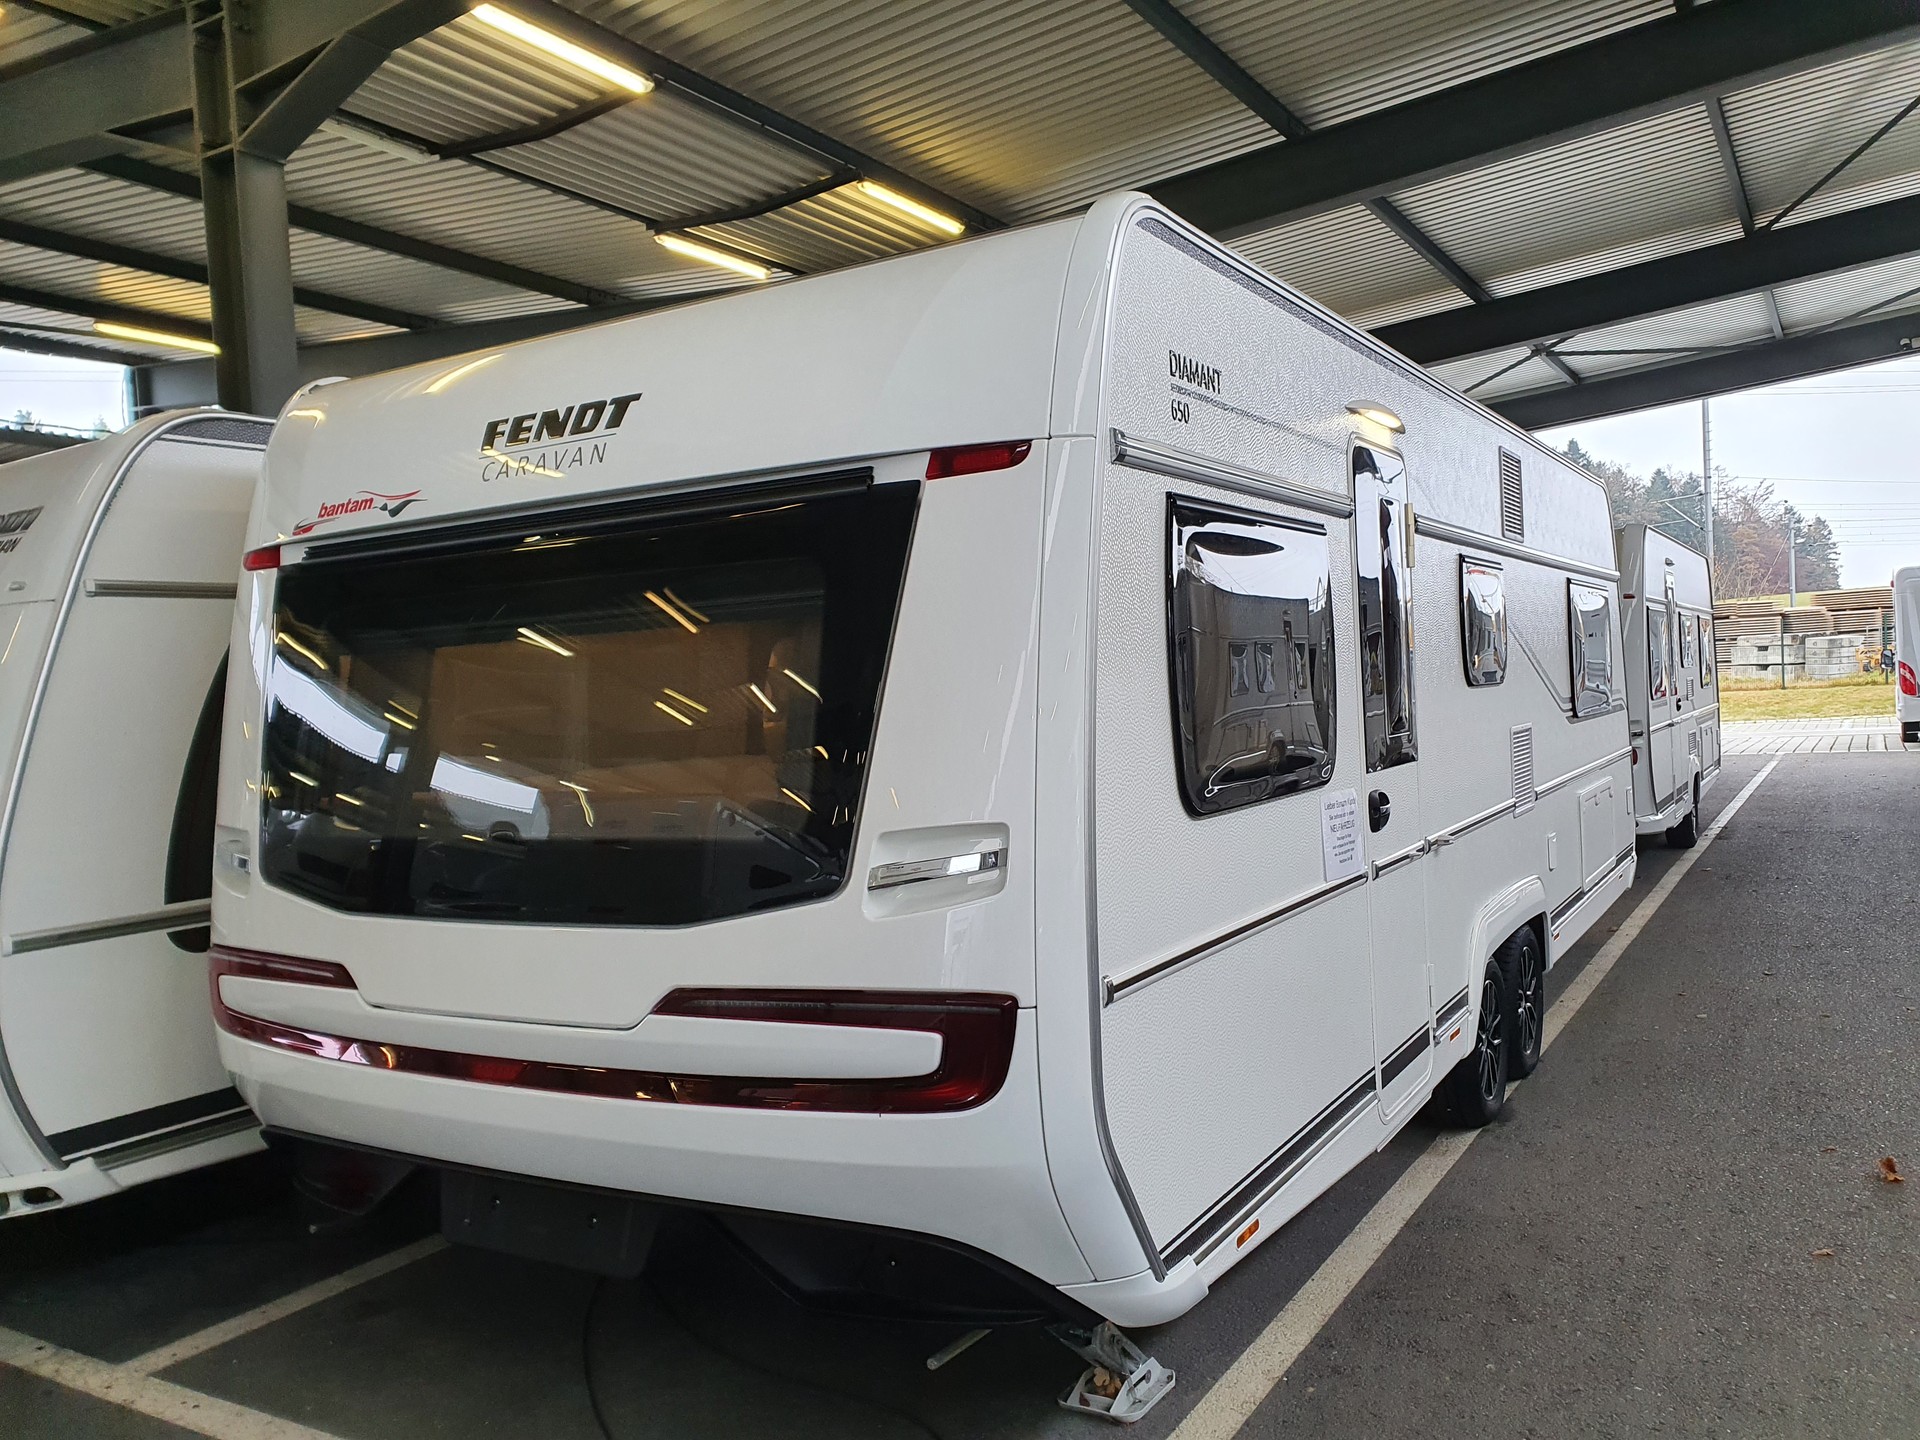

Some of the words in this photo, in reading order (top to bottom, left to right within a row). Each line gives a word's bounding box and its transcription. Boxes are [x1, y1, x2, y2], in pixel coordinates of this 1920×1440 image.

[1168, 349, 1222, 395] DIAMANT
[480, 392, 644, 453] FENDT
[1171, 398, 1190, 424] 650
[481, 442, 608, 483] CARAVAN
[317, 496, 375, 519] bantam
